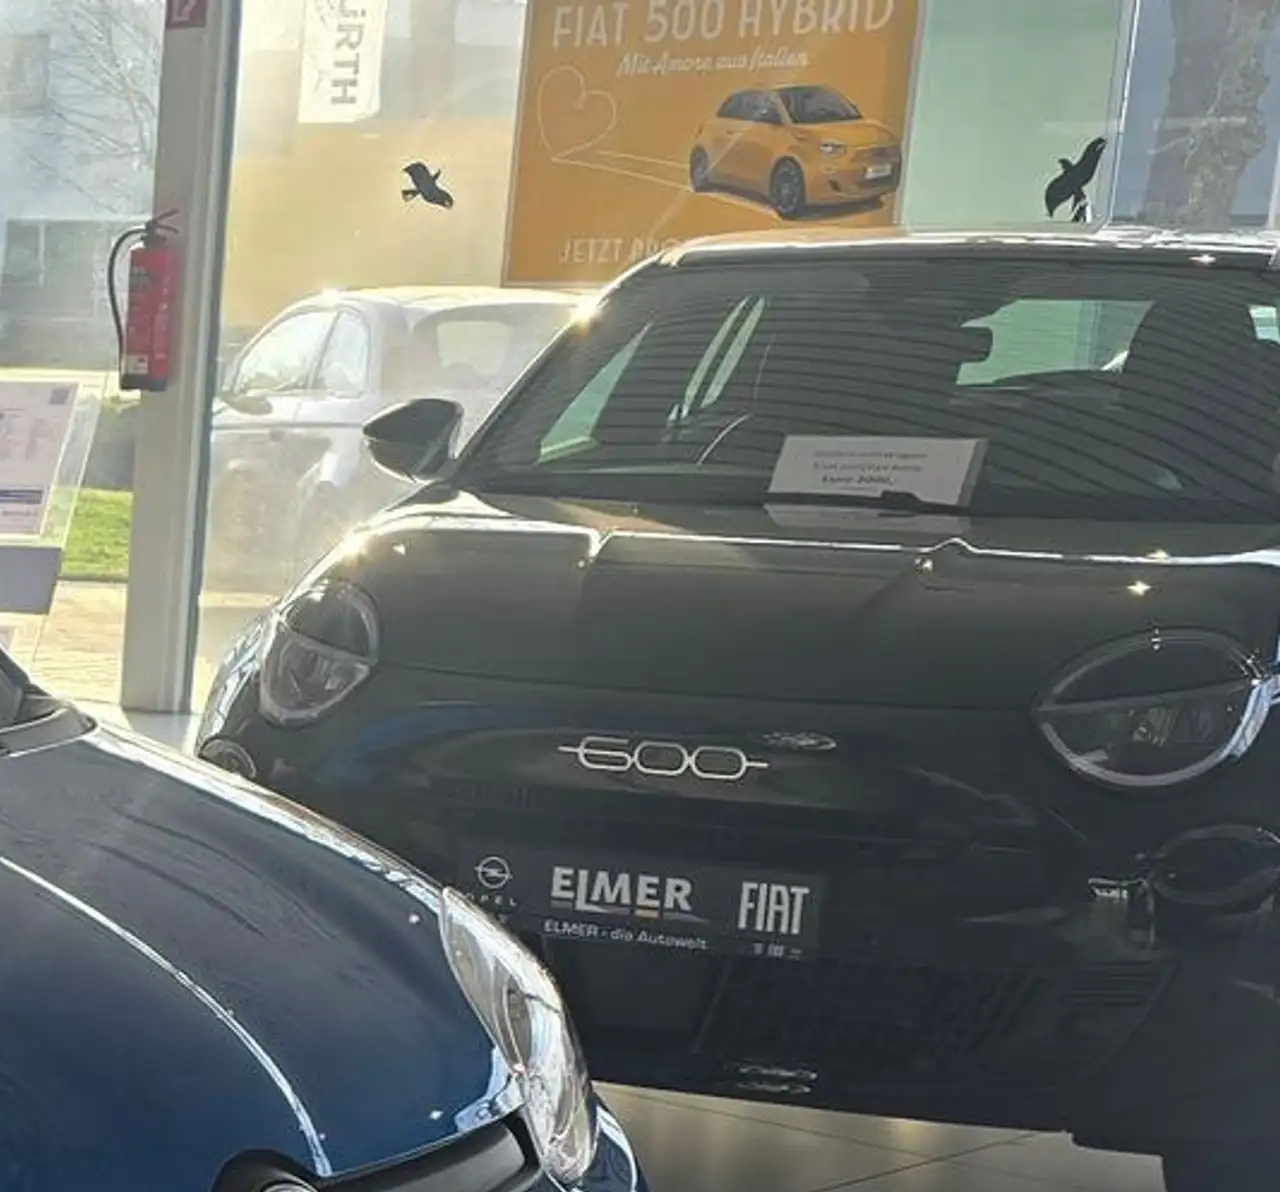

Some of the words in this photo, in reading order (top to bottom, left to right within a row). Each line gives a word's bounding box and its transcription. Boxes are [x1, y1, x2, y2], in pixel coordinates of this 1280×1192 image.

[552, 2, 630, 47] FIAT
[644, 0, 725, 43] 500
[738, 0, 894, 38] HYBRID
[558, 237, 624, 265] JETZT
[577, 735, 748, 780] 600
[550, 865, 693, 912] ELMER
[738, 881, 810, 935] FIAT
[544, 918, 599, 937] ELMER
